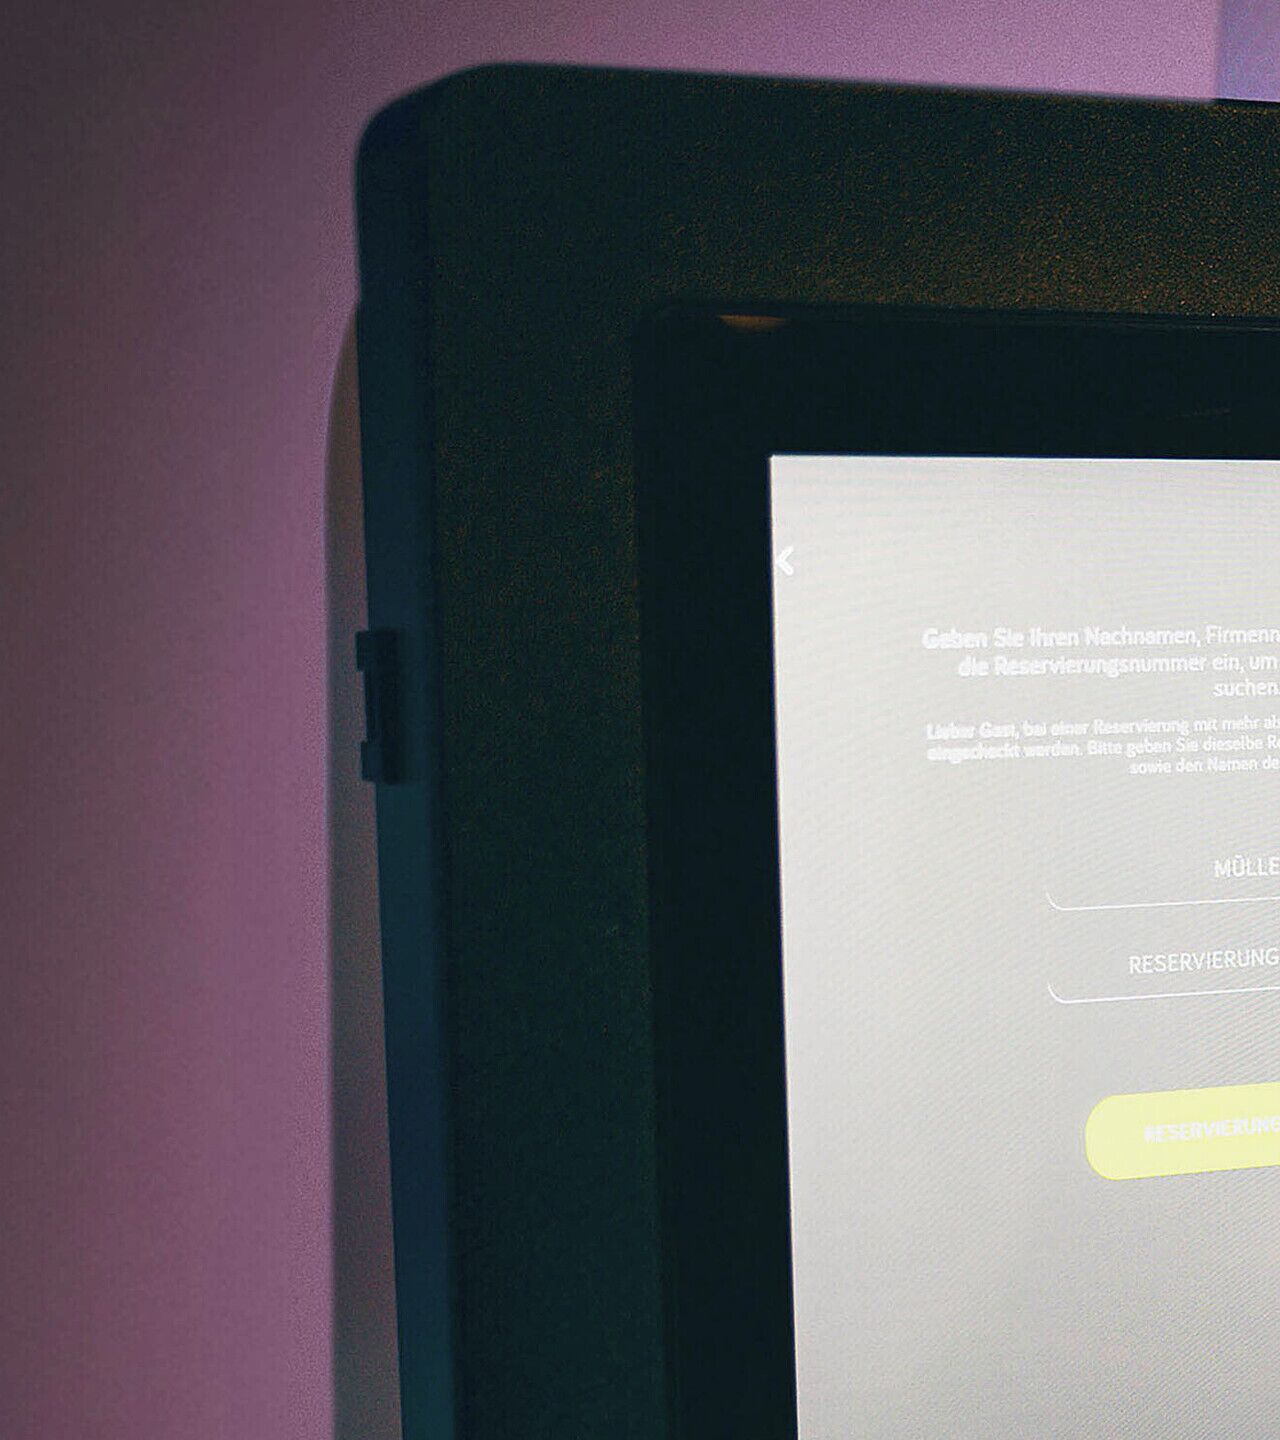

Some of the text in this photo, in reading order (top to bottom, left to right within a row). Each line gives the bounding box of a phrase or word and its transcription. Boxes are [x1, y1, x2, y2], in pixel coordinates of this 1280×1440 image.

[922, 627, 988, 649] Geben
[994, 626, 1024, 648] Sie
[1030, 626, 1079, 647] Ihren
[1085, 625, 1201, 647] Nachnamen,
[958, 655, 989, 677] die
[994, 655, 1206, 677] Reservierungsnummer
[1212, 653, 1244, 672] ein,
[1249, 653, 1278, 670] um
[1093, 719, 1190, 736] Reservierung
[1221, 715, 1260, 731] mehr
[1087, 740, 1122, 756] Bitte
[1126, 740, 1171, 758] geben
[1176, 738, 1198, 753] Sie
[1203, 735, 1263, 752] dieselbe
[1128, 759, 1172, 775] sowie
[1176, 758, 1203, 773] den
